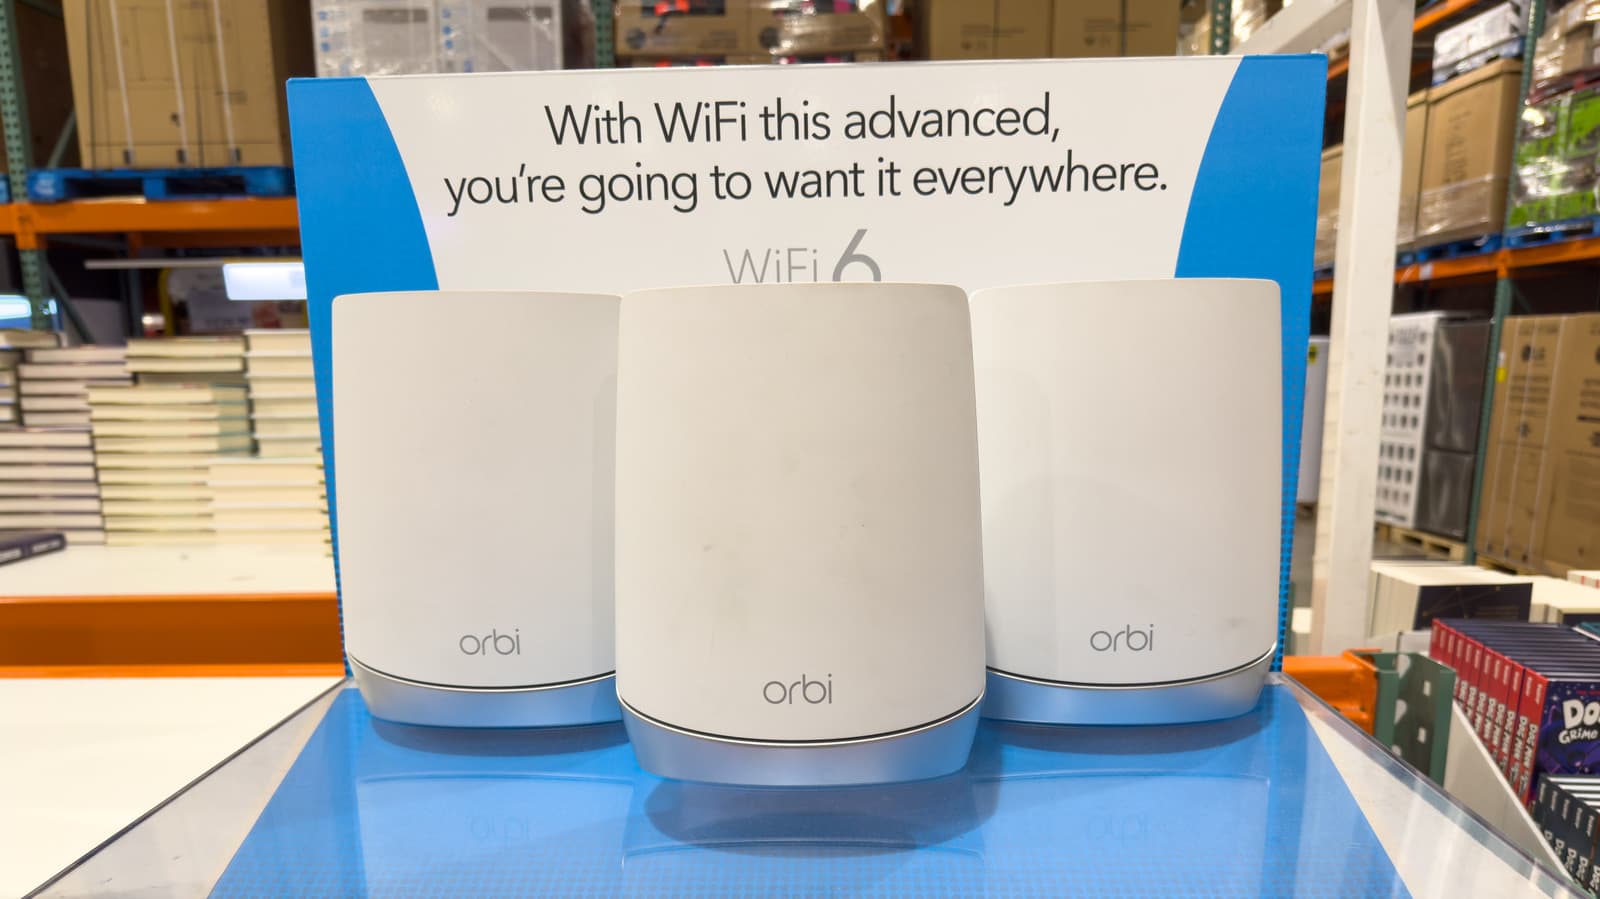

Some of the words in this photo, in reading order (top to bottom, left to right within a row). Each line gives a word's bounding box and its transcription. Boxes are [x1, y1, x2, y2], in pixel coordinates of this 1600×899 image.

[544, 101, 641, 145] With
[654, 101, 747, 142] WiFi
[759, 97, 831, 140] this
[845, 92, 1060, 142] advanced,
[444, 164, 565, 216] you're
[580, 162, 697, 214] going
[710, 166, 752, 199] to
[764, 163, 865, 199] want
[878, 157, 901, 197] it
[914, 150, 1167, 206] everywhere.
[723, 248, 818, 284] WiFi
[832, 229, 882, 282] 6
[459, 628, 521, 656] orbi
[1090, 624, 1154, 652] orbi
[763, 673, 833, 705] orbi
[1562, 699, 1600, 729] DO
